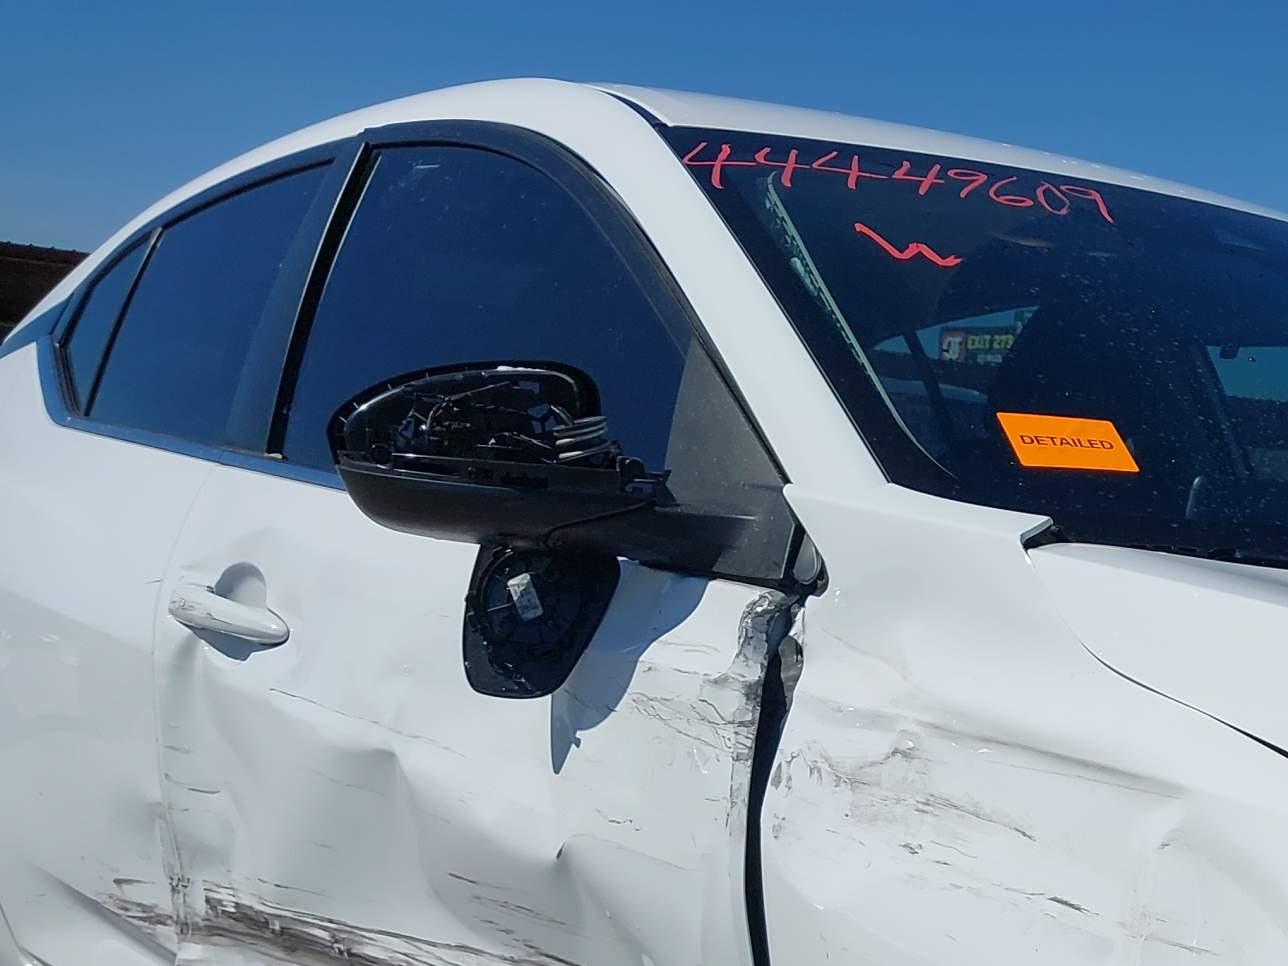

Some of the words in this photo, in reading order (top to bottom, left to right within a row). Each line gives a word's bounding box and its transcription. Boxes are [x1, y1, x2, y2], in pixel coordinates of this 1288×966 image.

[684, 142, 1114, 224] 44449609
[967, 334, 991, 350] EXIT
[1020, 434, 1114, 450] DETAILED
